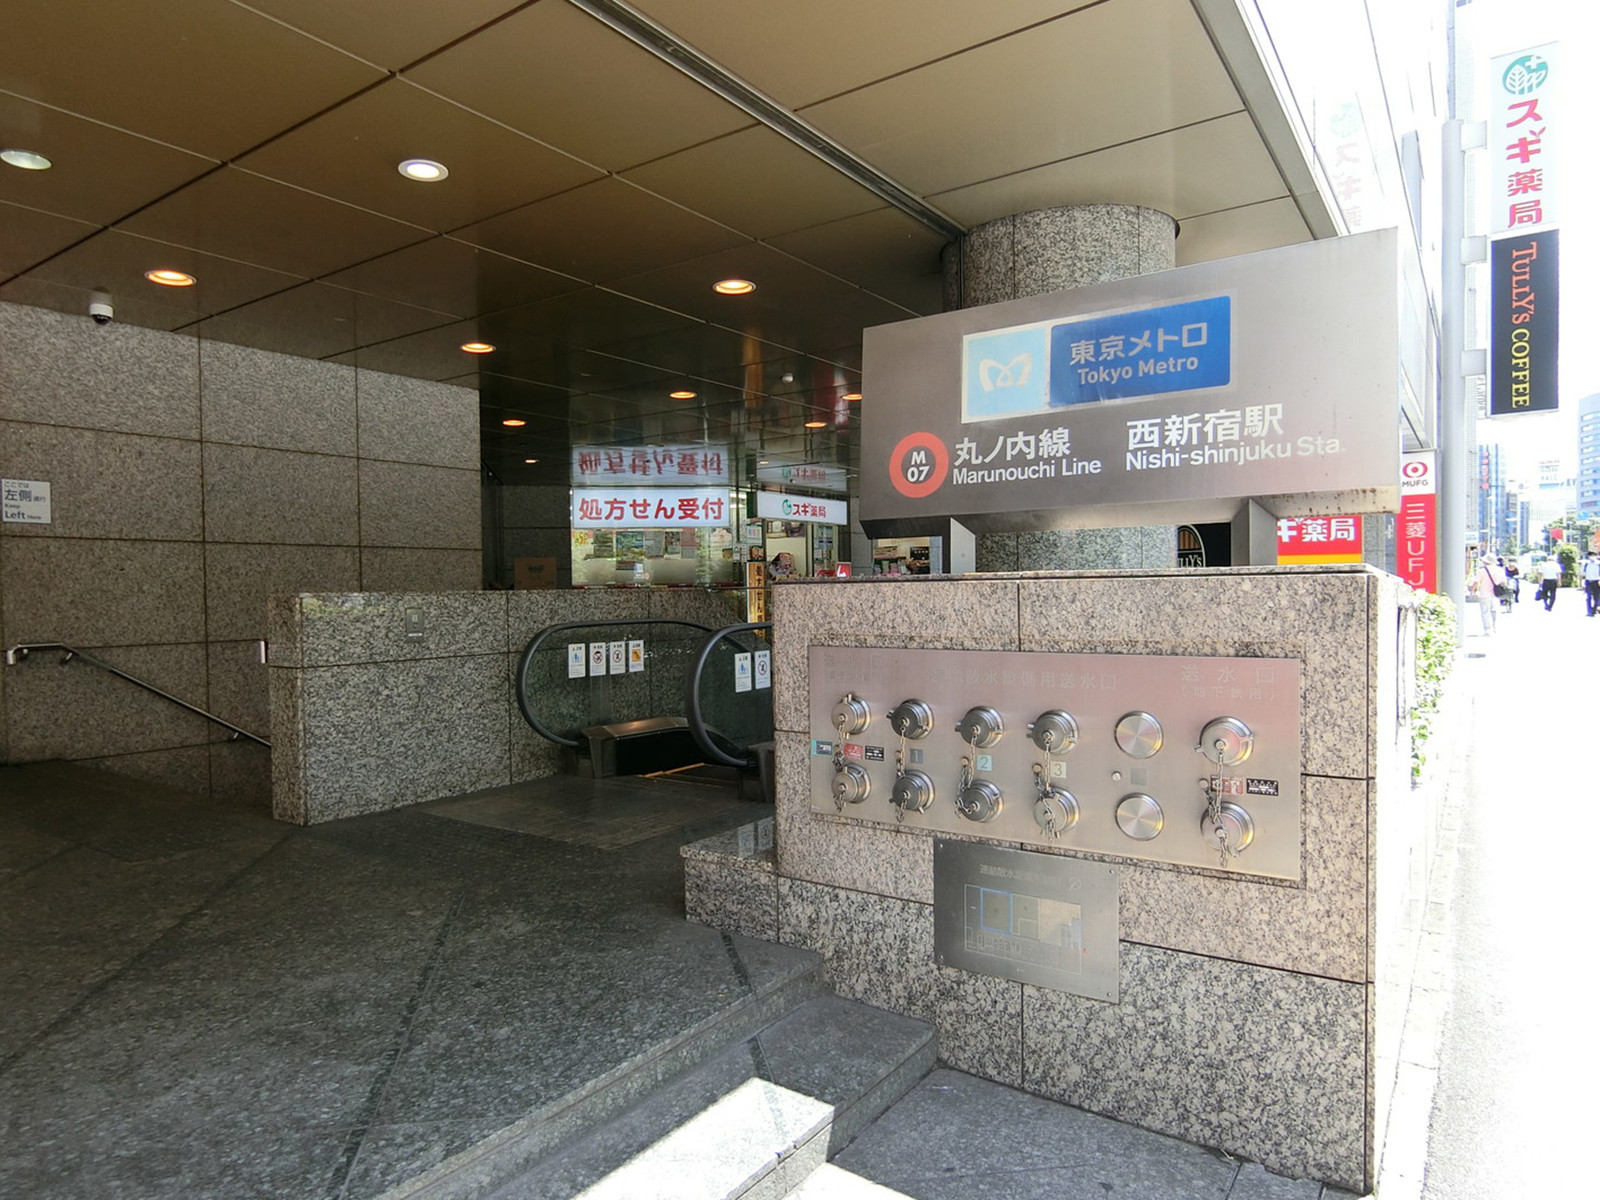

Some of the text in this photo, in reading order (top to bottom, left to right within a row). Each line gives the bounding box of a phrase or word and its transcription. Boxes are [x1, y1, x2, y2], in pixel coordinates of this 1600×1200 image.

[1505, 98, 1546, 228] スギ薬局
[1511, 241, 1537, 408] TULLY'S COFFEE
[1069, 322, 1208, 366] 東京メトロ
[1077, 356, 1199, 385] Tokyo Metro
[1126, 403, 1284, 450] 西新宿駅
[910, 450, 926, 466] M
[953, 426, 1071, 466] 丸ノ内線
[1126, 436, 1347, 471] Nishi-shinjuku Sta.
[907, 465, 930, 483] 07
[952, 458, 1101, 485] Marunouchi Line
[1401, 479, 1429, 487] MUFG
[5, 511, 26, 519] Left
[579, 498, 724, 520] 処方せん受付
[792, 502, 827, 518] スギ薬局
[1405, 503, 1427, 586] 三菱UFJ
[979, 756, 989, 769] 2
[1053, 763, 1063, 776] 3
